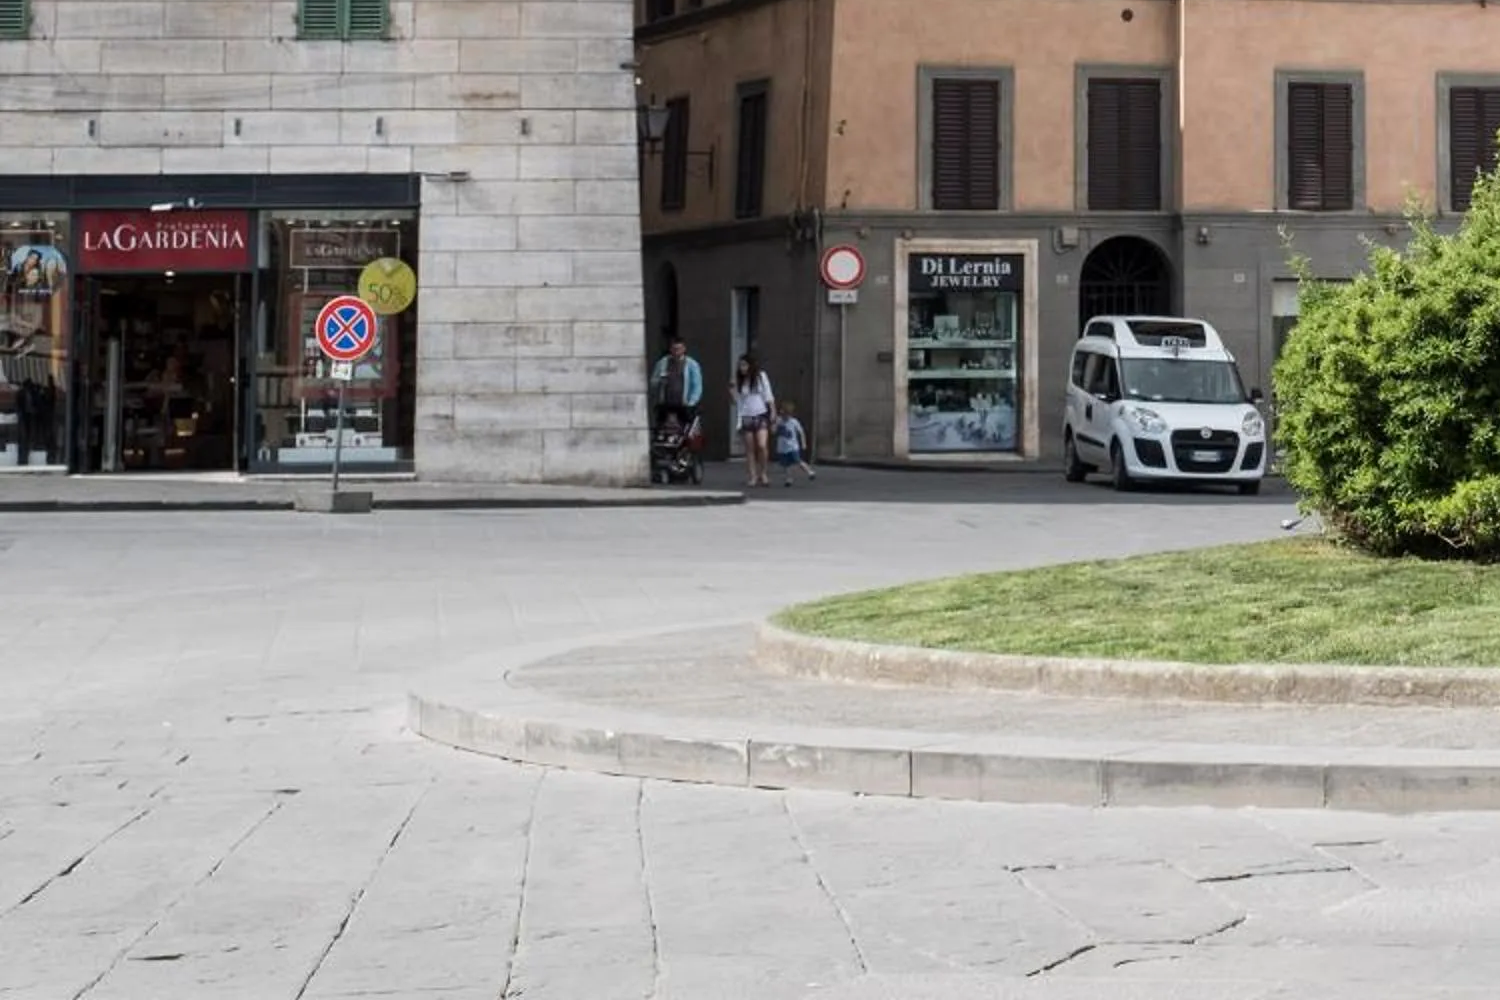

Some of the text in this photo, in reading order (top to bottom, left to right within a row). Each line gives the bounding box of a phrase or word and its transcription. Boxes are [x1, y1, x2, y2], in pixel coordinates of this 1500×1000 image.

[921, 257, 1012, 275] Di Lernia
[930, 275, 1001, 288] JEWELRY
